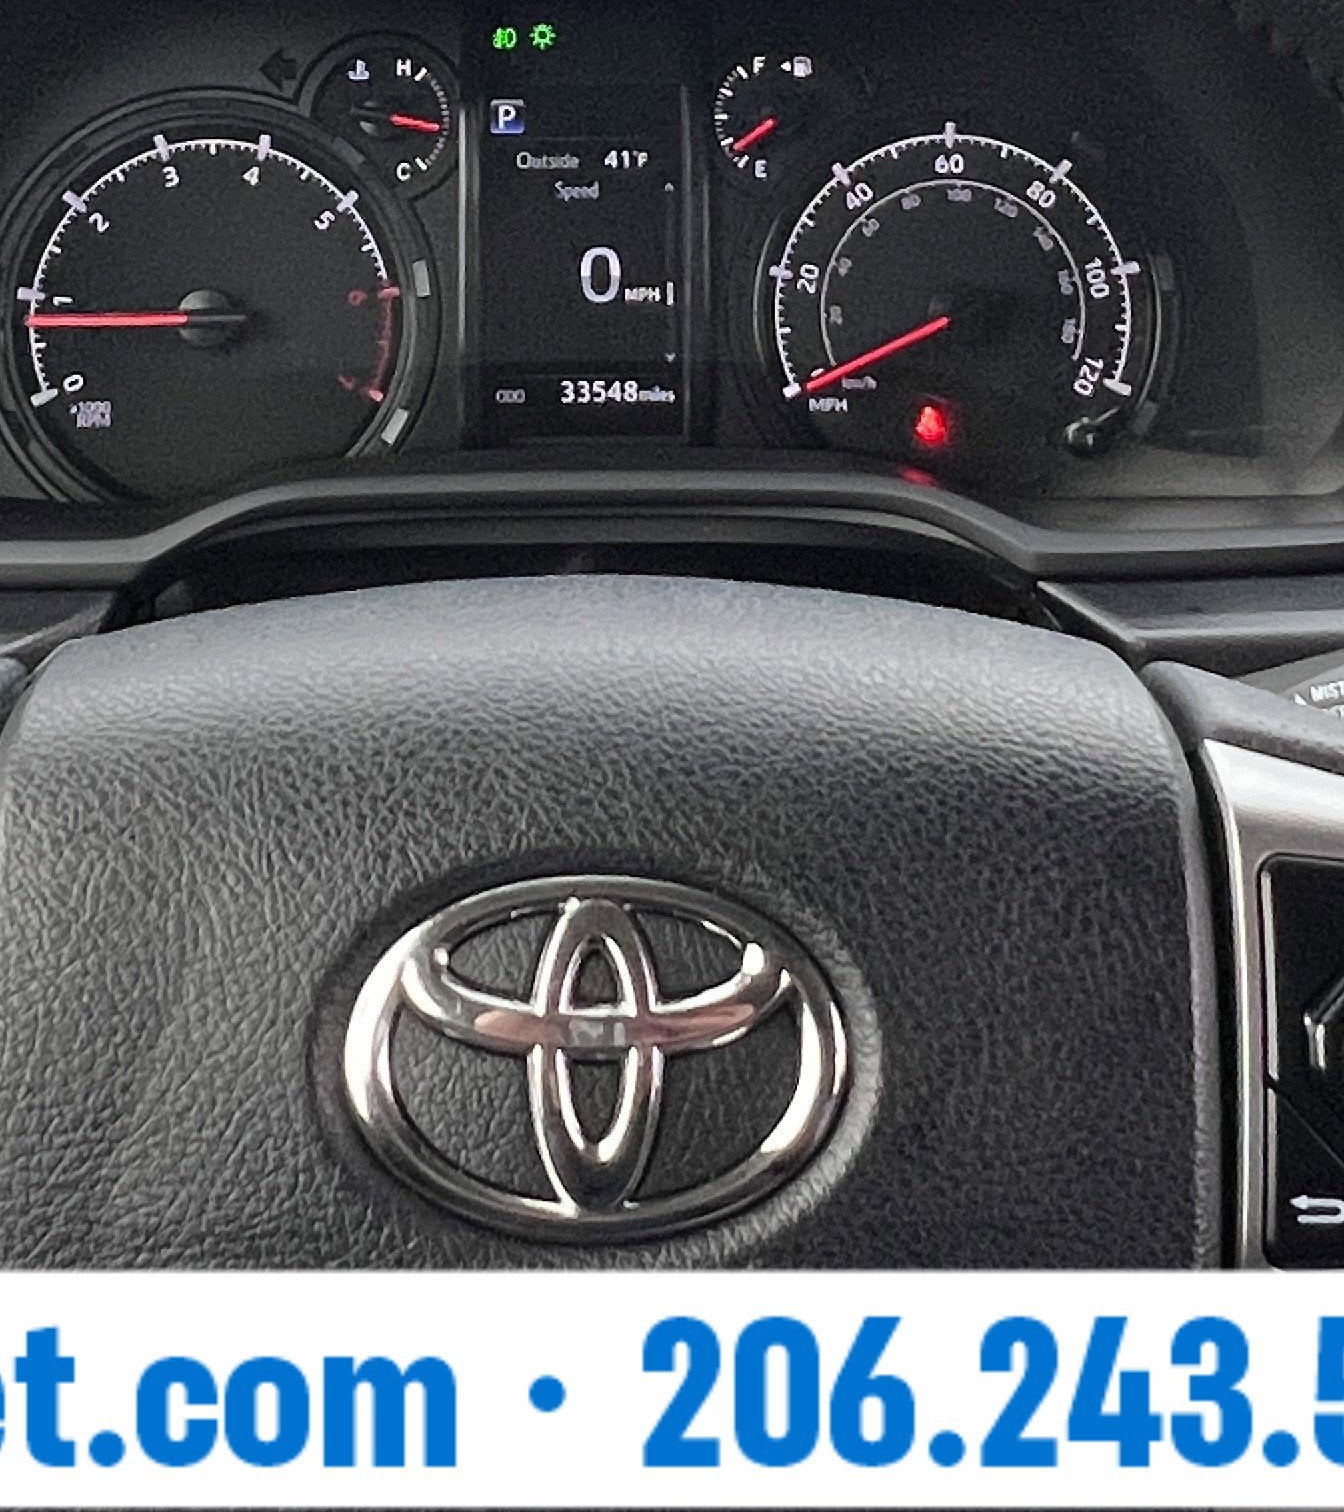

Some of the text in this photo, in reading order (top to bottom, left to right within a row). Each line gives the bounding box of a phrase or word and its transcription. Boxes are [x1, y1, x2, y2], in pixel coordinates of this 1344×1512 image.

[396, 59, 412, 76] H
[753, 56, 766, 75] F
[497, 105, 517, 129] P
[515, 151, 580, 170] Outside
[754, 159, 768, 178] E
[933, 153, 965, 174] 60
[163, 167, 180, 187] 3
[242, 167, 260, 185] 4
[395, 162, 411, 181] C
[554, 180, 600, 202] Speed
[845, 181, 874, 211] 40
[1025, 180, 1056, 208] 80
[88, 213, 110, 232] 2
[314, 210, 335, 230] 5
[579, 246, 661, 304] 0 MPH
[796, 263, 819, 294] 20
[1083, 257, 1110, 299] 100
[63, 373, 84, 392] 0
[1073, 355, 1104, 397] 120
[808, 396, 848, 413] MPH
